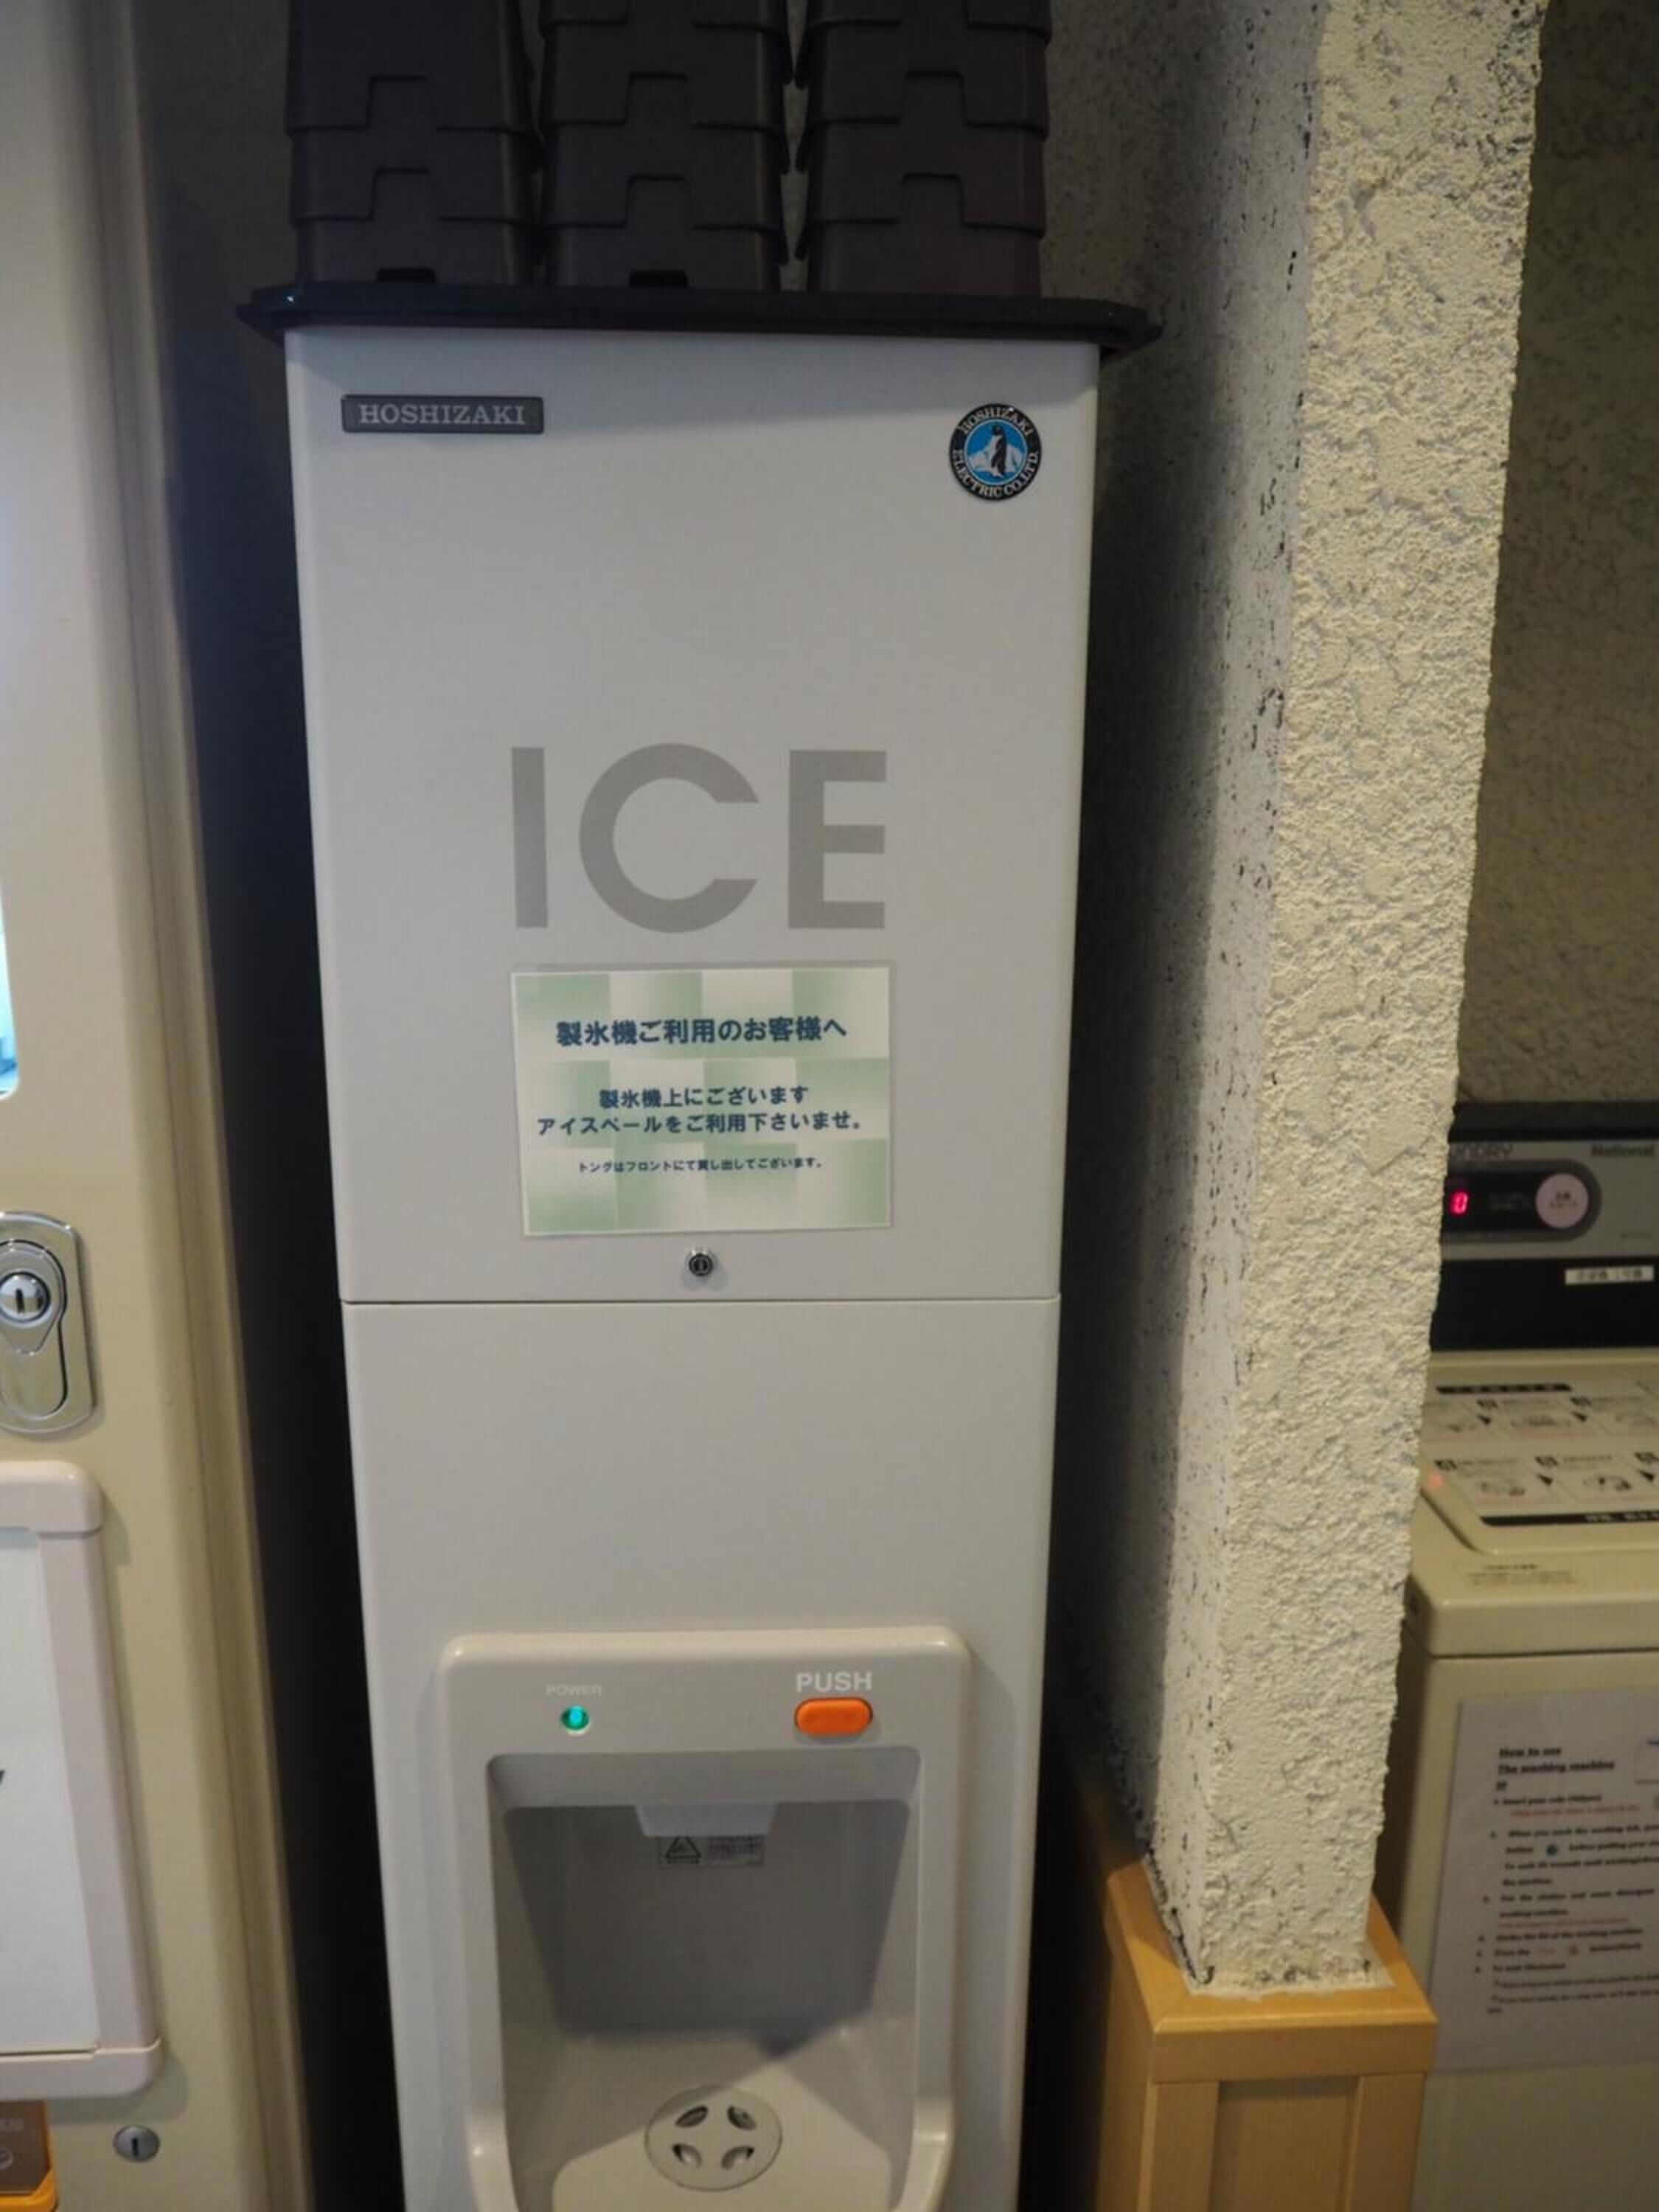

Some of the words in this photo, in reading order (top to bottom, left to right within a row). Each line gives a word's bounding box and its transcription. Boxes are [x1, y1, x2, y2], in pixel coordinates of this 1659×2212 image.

[358, 403, 526, 425] HOSHIZAKI
[957, 406, 1034, 437] HOSHIZAKI
[512, 743, 886, 933] ICE
[556, 1016, 847, 1047] 製氷機ご利用のお客様へ
[599, 1085, 809, 1110] 製氷機上にございます
[537, 1110, 860, 1136] アイスペールをご利用下さいませ。
[546, 1684, 602, 1697] POWER
[796, 1671, 873, 1693] PUSH
